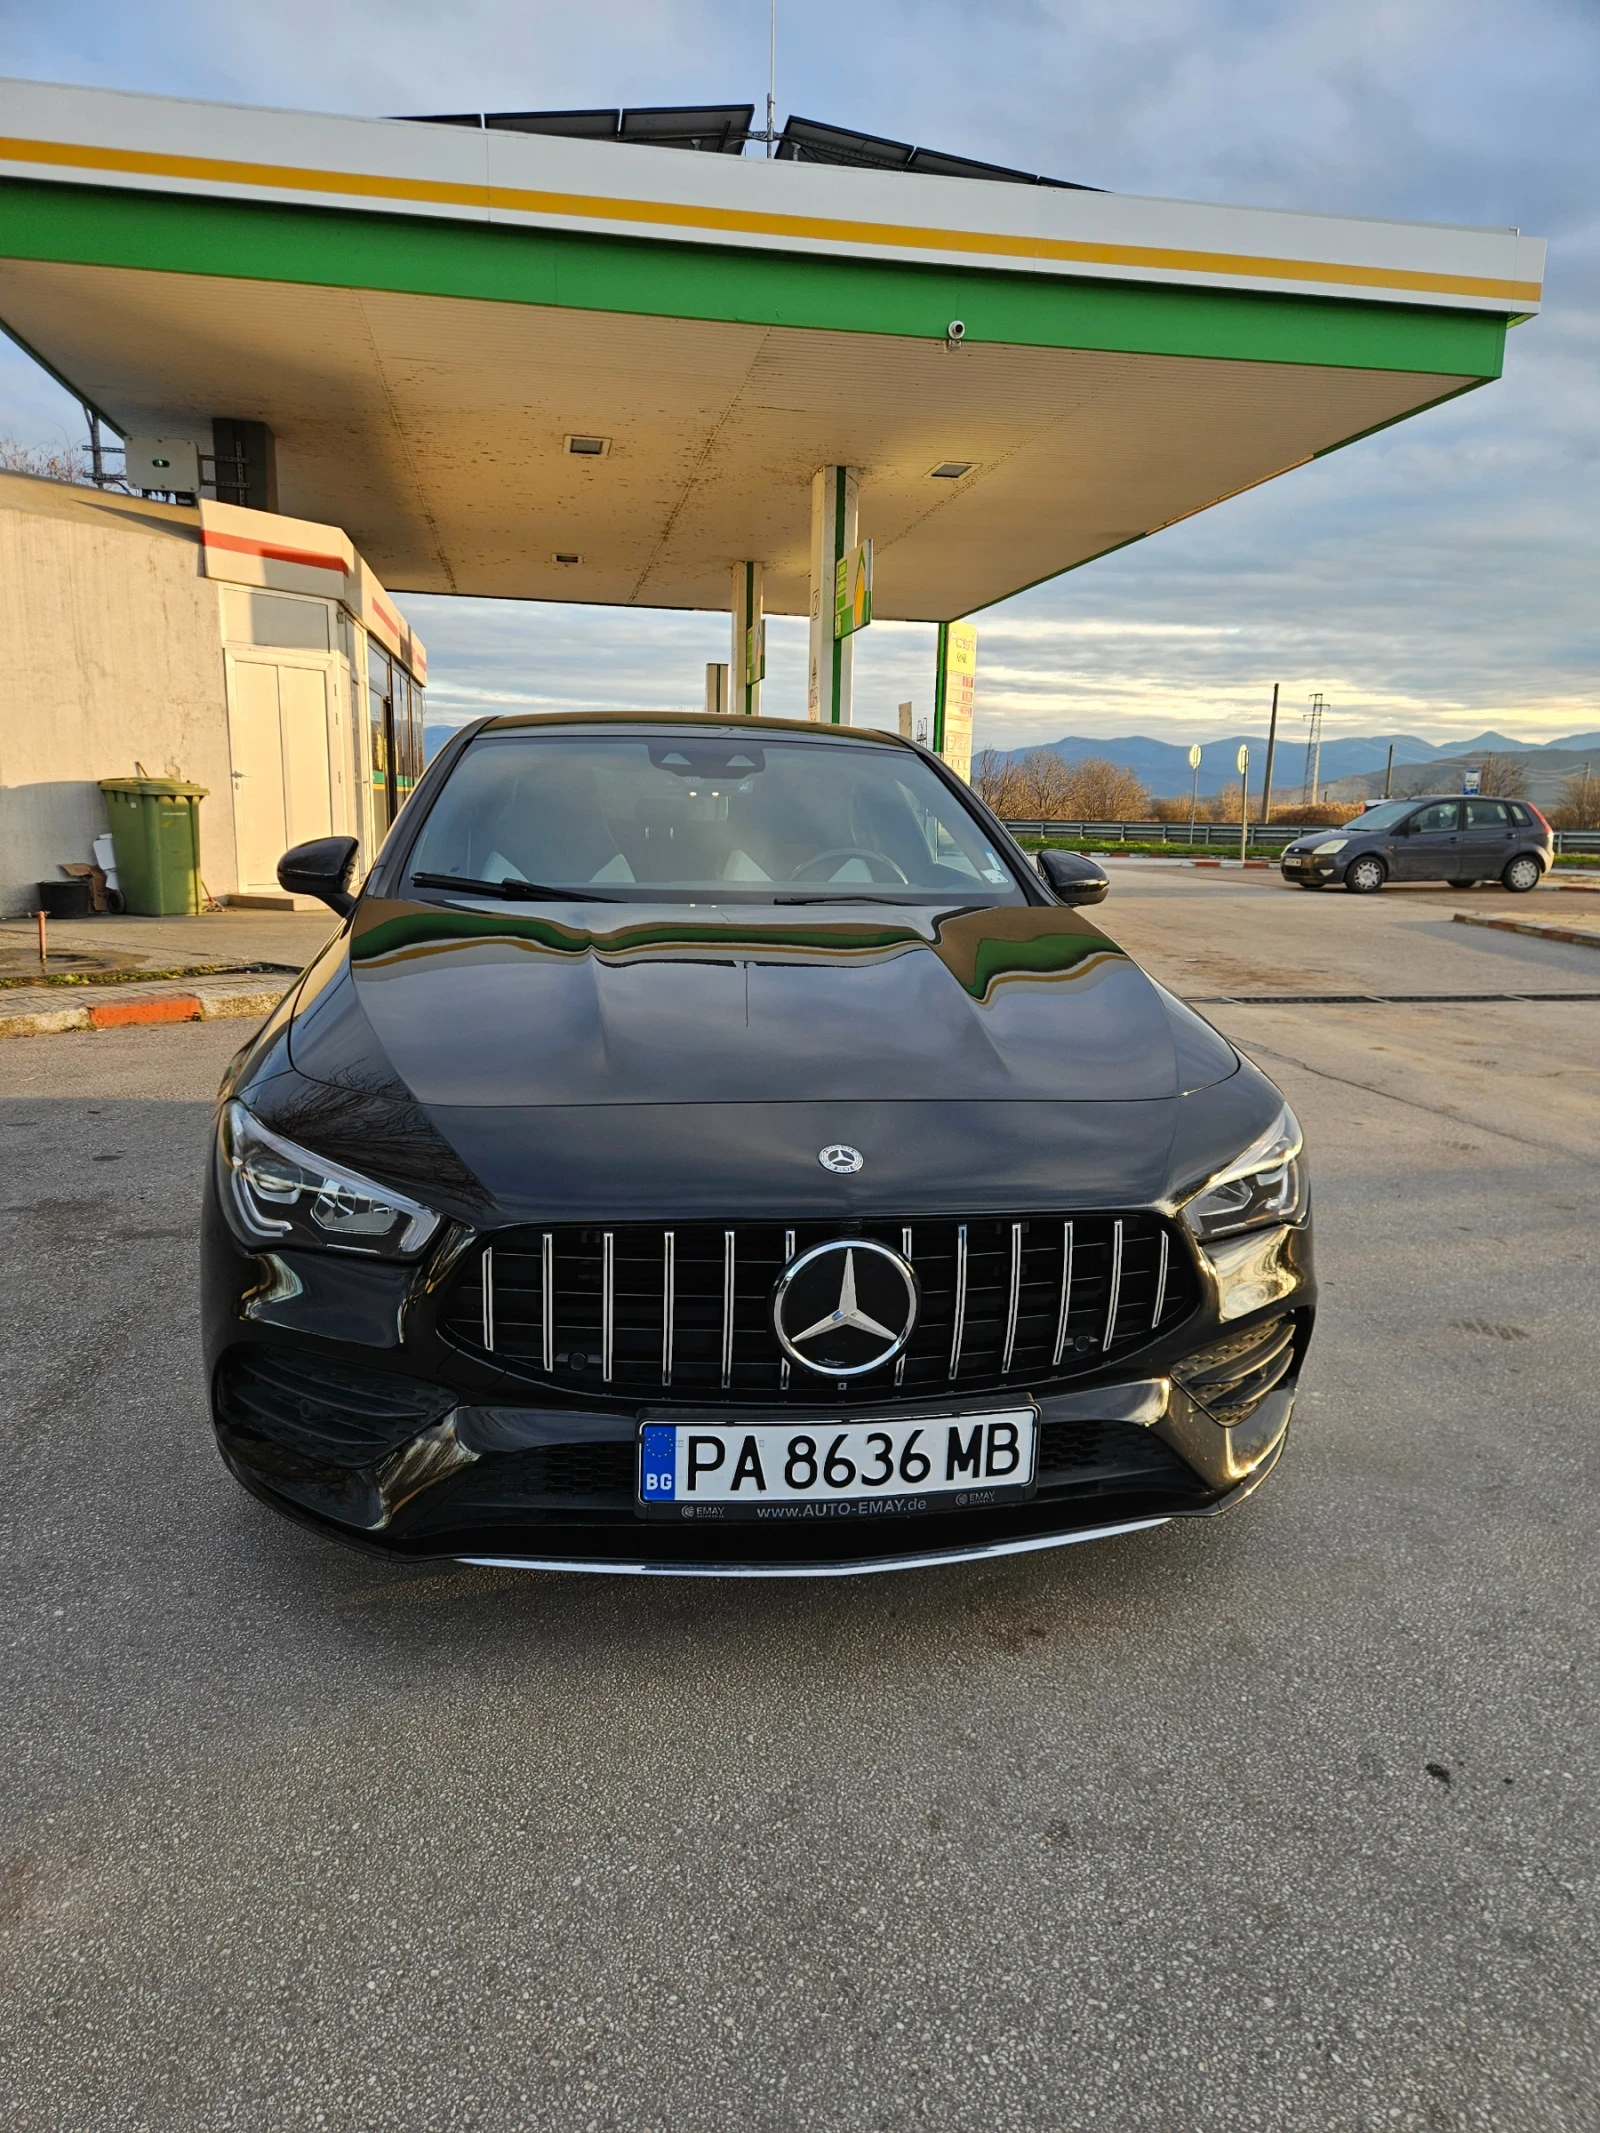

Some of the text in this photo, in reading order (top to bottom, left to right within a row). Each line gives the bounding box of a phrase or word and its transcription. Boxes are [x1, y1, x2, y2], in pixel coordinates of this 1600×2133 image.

[687, 1422, 1019, 1491] PA 8636 MB
[646, 1473, 672, 1491] BG
[969, 1491, 995, 1501] EMAY
[696, 1506, 725, 1515] EMAY
[757, 1498, 927, 1518] www.AUTO-EMAY.de
